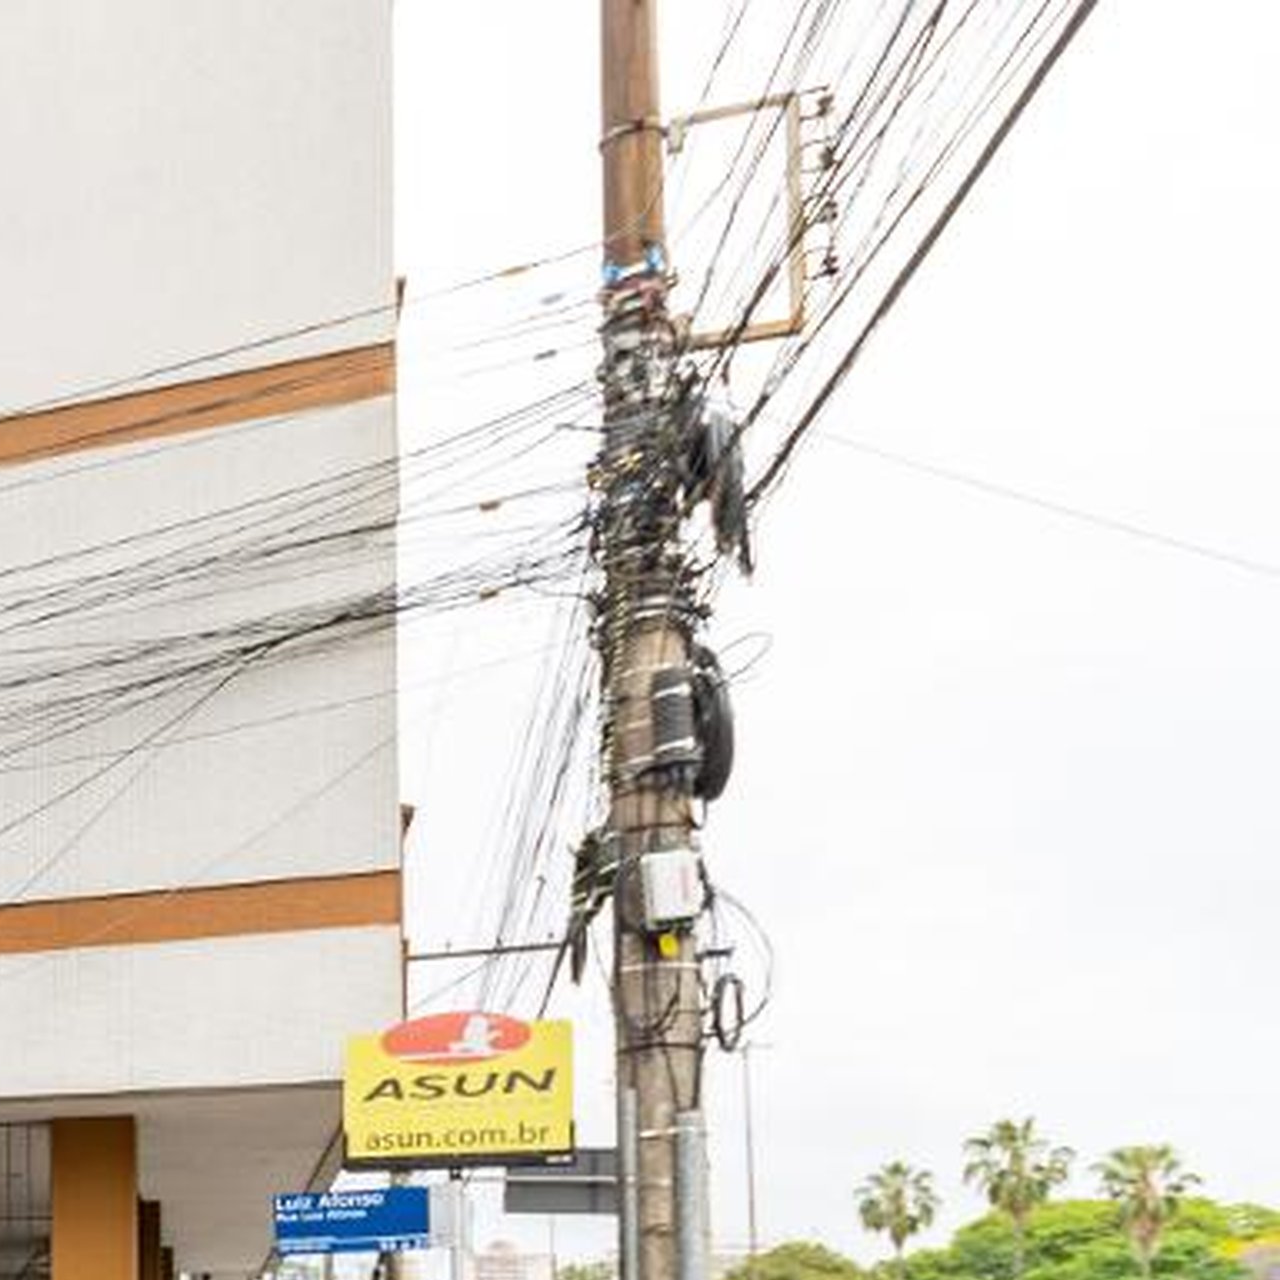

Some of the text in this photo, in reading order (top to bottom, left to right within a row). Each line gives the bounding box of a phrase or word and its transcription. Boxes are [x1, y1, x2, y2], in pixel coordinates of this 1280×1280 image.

[363, 1067, 557, 1101] ASUN
[365, 1120, 550, 1151] asun.com.br
[318, 1192, 385, 1209] Afonso
